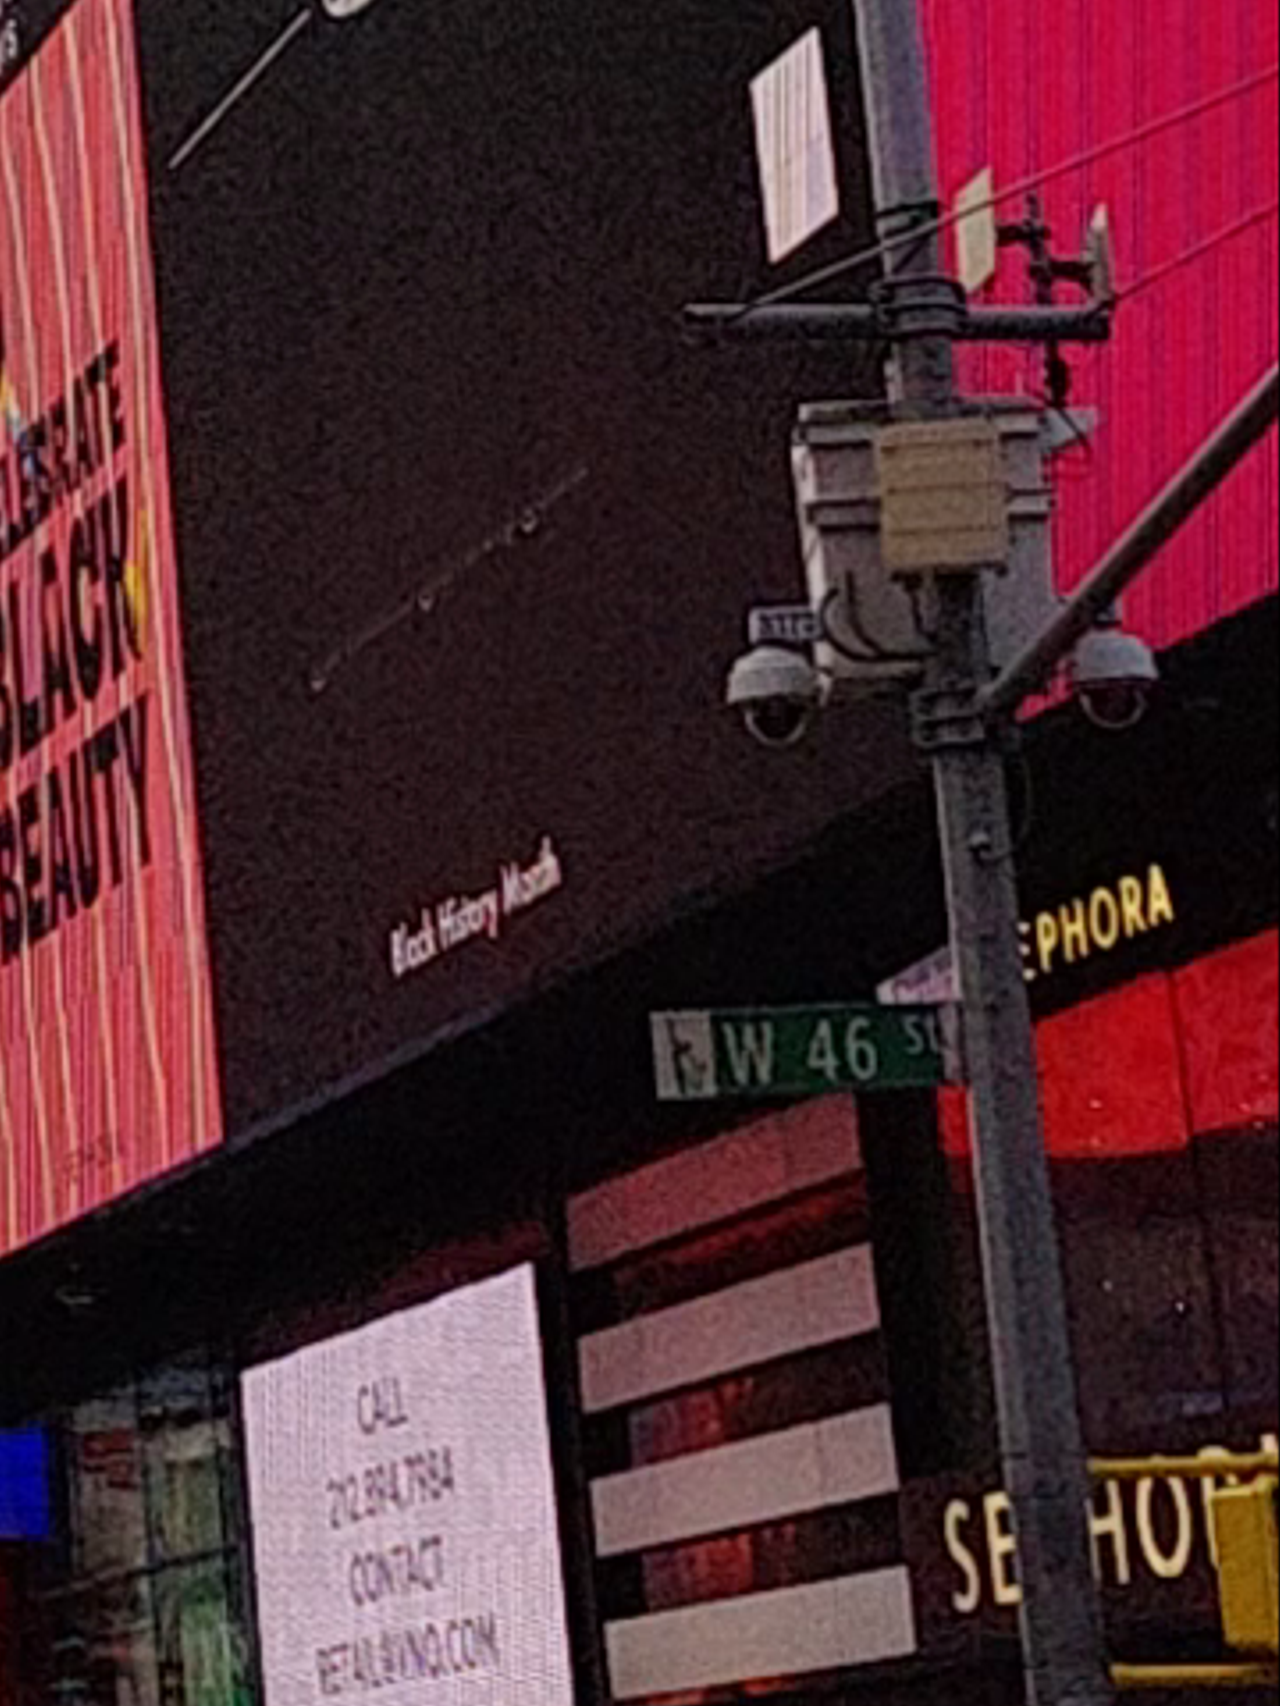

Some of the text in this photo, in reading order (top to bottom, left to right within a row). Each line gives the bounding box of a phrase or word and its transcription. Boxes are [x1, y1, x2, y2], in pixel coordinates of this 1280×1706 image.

[436, 887, 499, 953] History
[498, 834, 563, 916] Month
[1017, 863, 1176, 982] PHORA
[721, 1021, 775, 1086] W
[806, 1016, 879, 1082] 46
[355, 1375, 410, 1436] CALL
[347, 1534, 445, 1608] CONTACT
[942, 1432, 1280, 1614] SEHO
